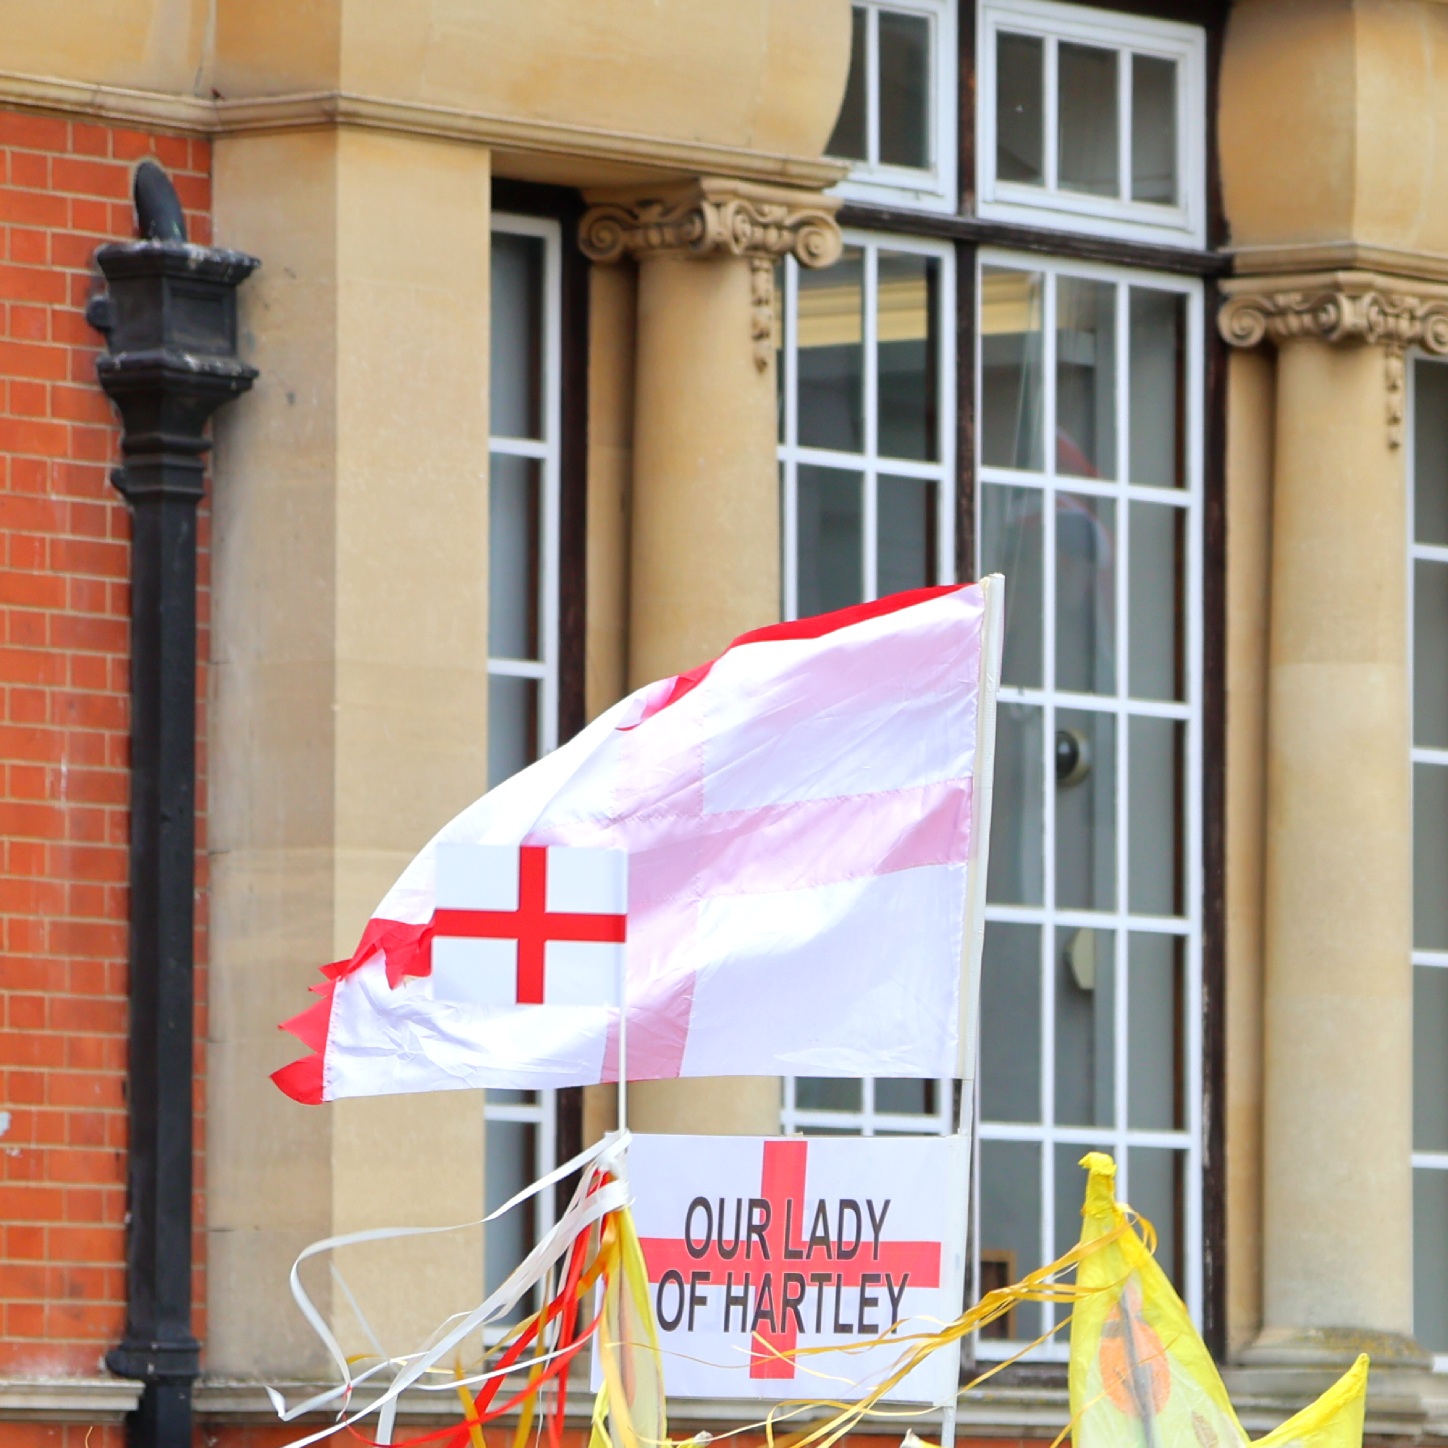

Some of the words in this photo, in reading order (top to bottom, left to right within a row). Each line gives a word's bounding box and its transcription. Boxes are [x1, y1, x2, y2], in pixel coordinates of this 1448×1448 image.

[684, 1196, 772, 1261] OUR
[783, 1198, 892, 1261] LADY
[656, 1269, 711, 1332] OF
[723, 1272, 909, 1335] HARTLEY
